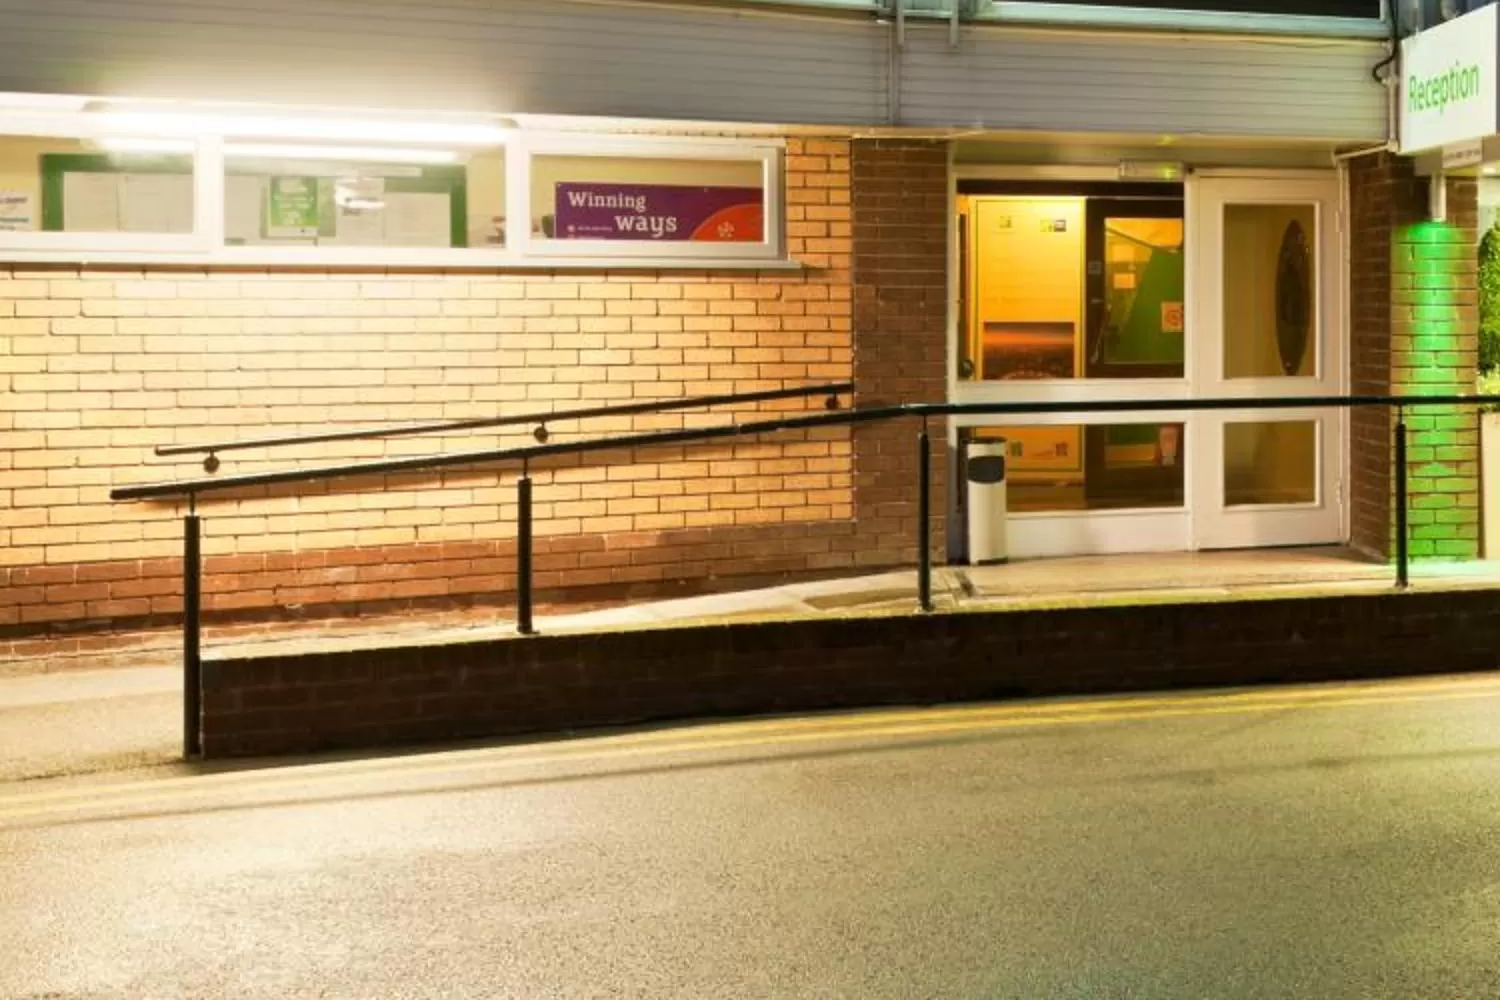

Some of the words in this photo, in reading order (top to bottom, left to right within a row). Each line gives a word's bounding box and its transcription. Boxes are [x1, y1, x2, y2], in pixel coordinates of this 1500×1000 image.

[1408, 60, 1479, 115] Reception
[567, 191, 647, 212] Winning
[614, 214, 677, 238] ways
